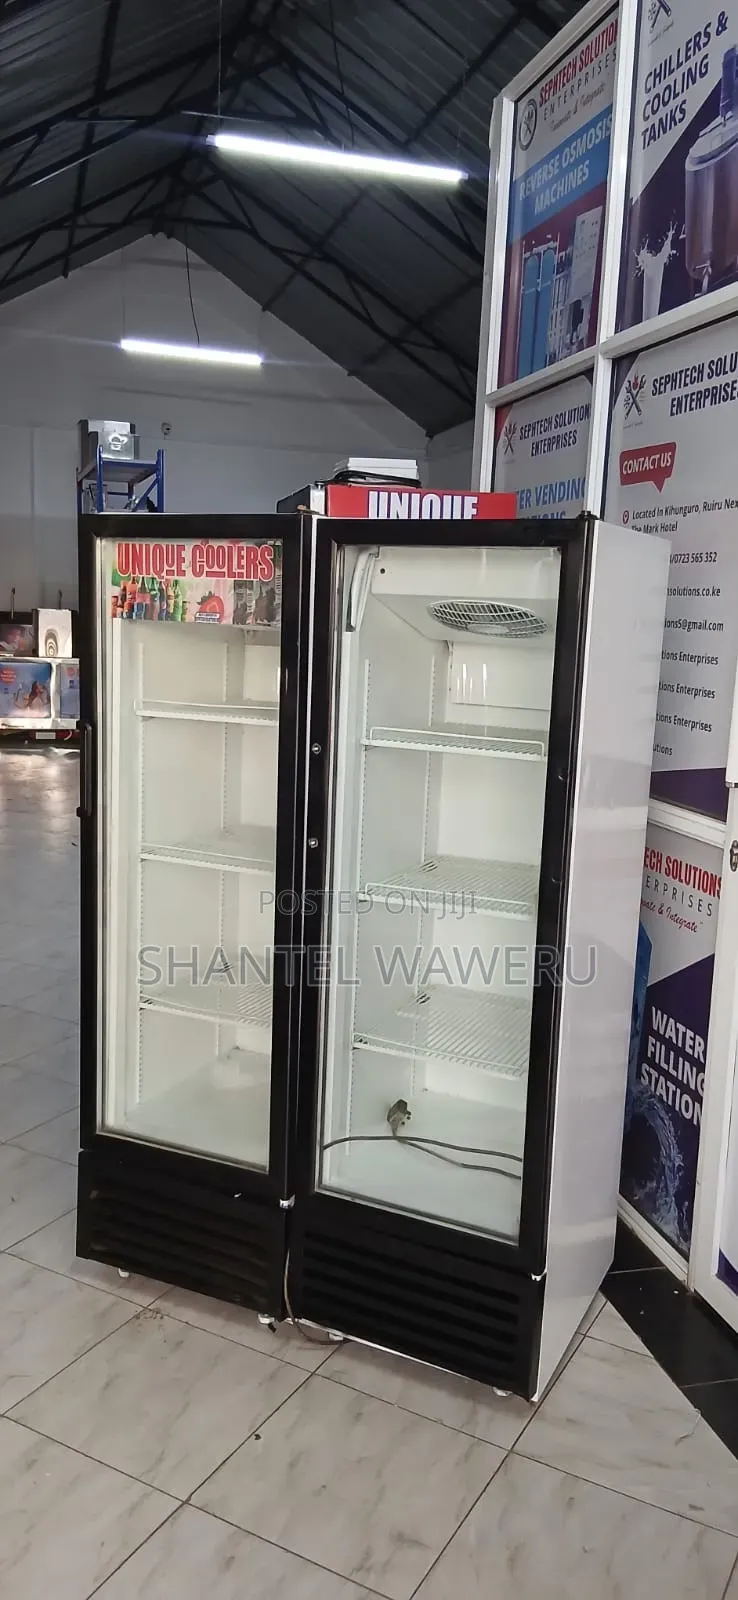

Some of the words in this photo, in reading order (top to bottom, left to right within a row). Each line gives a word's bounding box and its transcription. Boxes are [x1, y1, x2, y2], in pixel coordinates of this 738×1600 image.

[644, 22, 712, 94] CHILLERS
[715, 11, 729, 36] &
[539, 55, 577, 108] SEPHTECH
[544, 47, 617, 120] ENTERPRISES
[643, 53, 709, 122] COOLING
[641, 99, 687, 150] TANKS
[519, 154, 560, 201] REVERSE
[534, 159, 590, 216] MACHINES
[651, 362, 705, 396] SEPHTECH
[670, 379, 738, 417] ENTERPRISE
[519, 416, 553, 441] SEPHTECH
[553, 403, 592, 430] SOLUTION
[531, 429, 578, 457] ENTERPRISES
[622, 454, 660, 475] CONTACT
[661, 451, 673, 467] US
[516, 488, 532, 510] ER
[632, 508, 656, 521] Located
[657, 507, 664, 517] In
[664, 503, 701, 518] Kihunguro,
[702, 500, 723, 513] Ruiru
[643, 523, 659, 534] Mark
[660, 521, 678, 533] Hotel
[116, 542, 187, 583] UNIQUE
[191, 543, 275, 582] COOLERS
[691, 552, 703, 564] 565
[704, 551, 718, 563] 352
[679, 651, 719, 666] Enterprises
[676, 683, 716, 699] Enterprises
[656, 712, 672, 724] tions
[673, 715, 712, 732] Enterprises
[646, 875, 713, 917] ERPRISES
[657, 902, 665, 915] &
[651, 1006, 705, 1063] WATER
